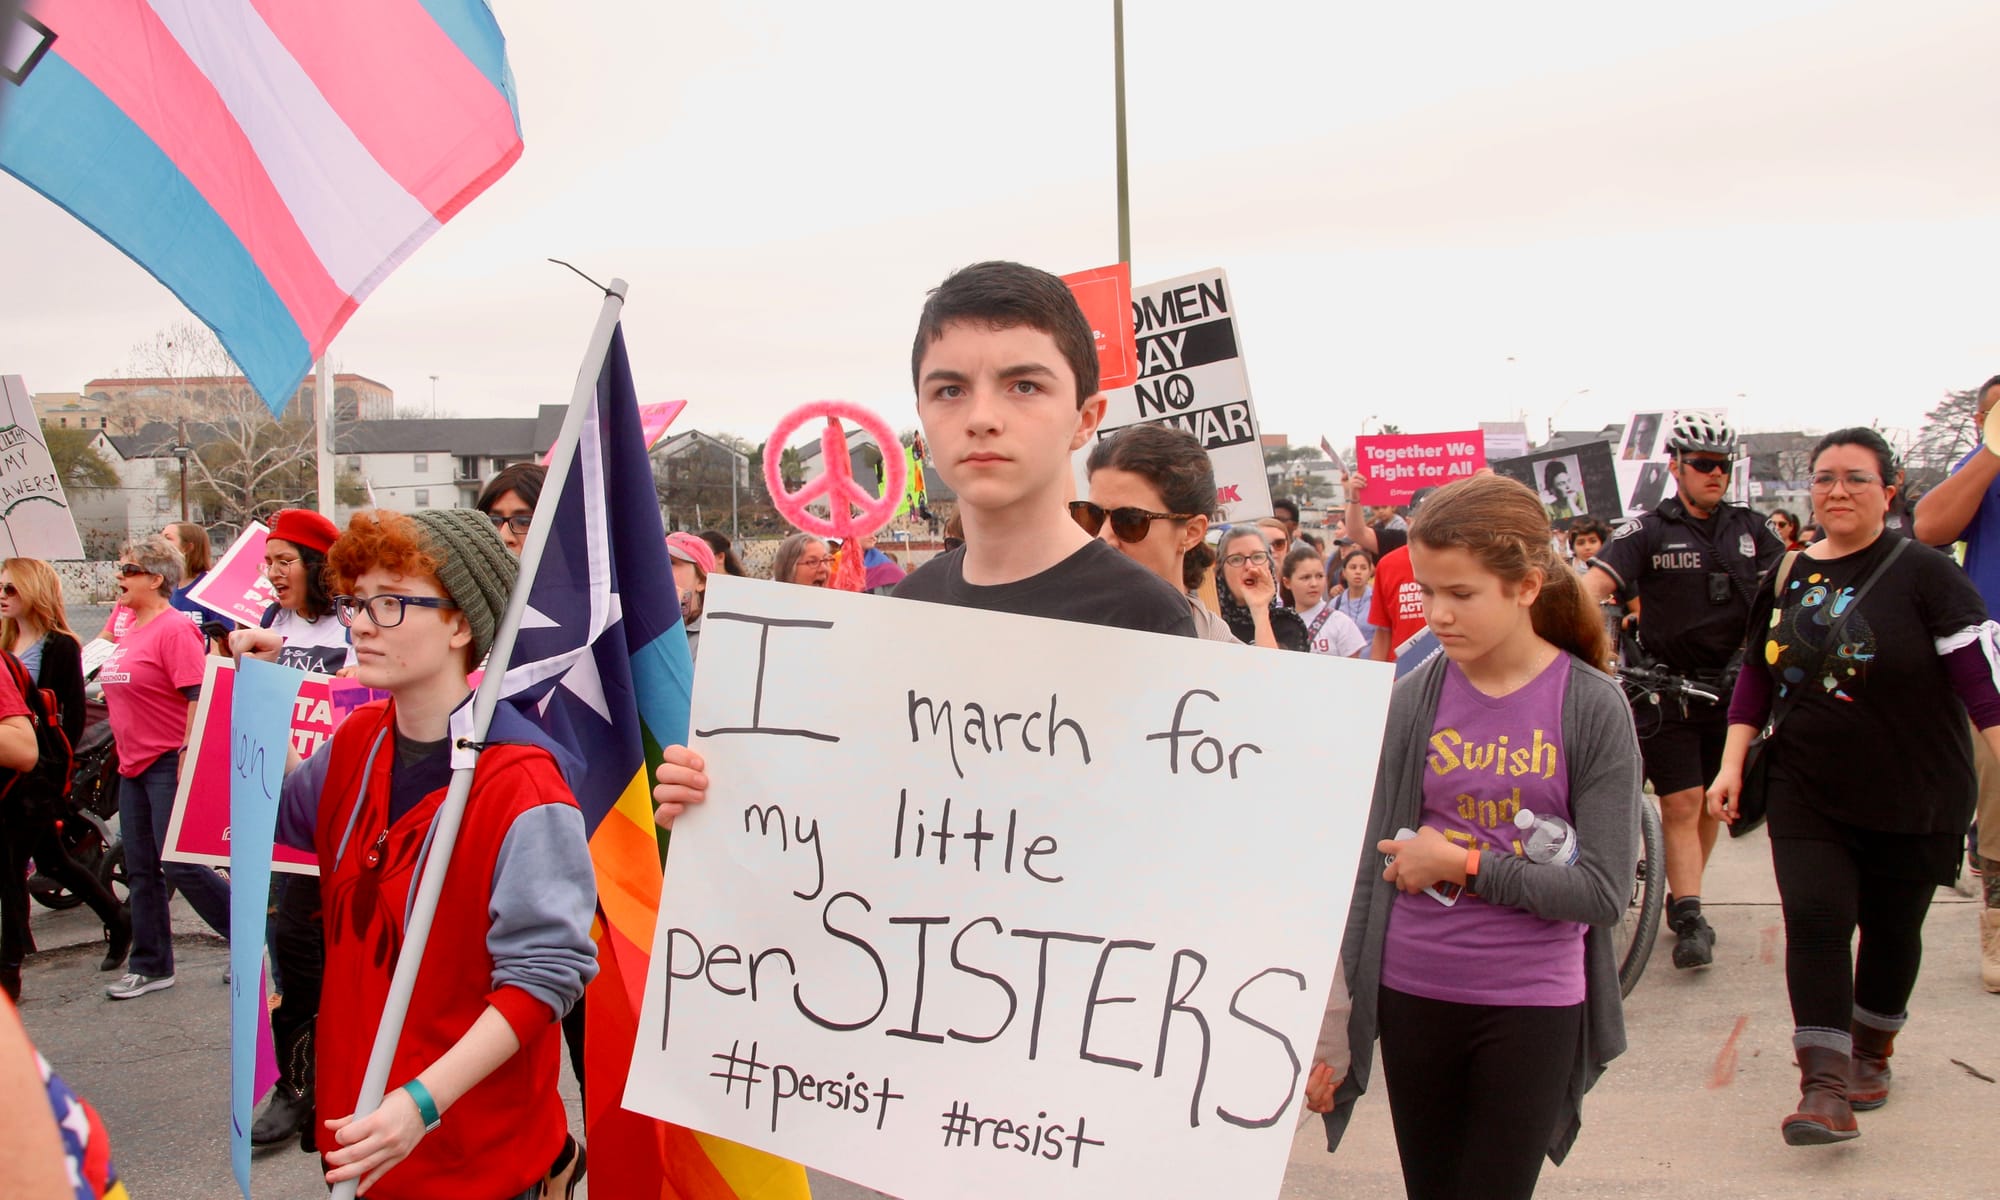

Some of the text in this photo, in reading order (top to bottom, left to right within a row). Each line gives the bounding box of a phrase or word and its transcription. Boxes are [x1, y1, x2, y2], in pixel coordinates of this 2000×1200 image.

[1132, 279, 1227, 335] MEN
[1134, 373, 1194, 419] NO
[5, 448, 28, 472] MY
[1365, 444, 1443, 462] Together
[1446, 442, 1475, 457] We
[1370, 461, 1473, 481] Fight for All
[1, 474, 58, 505] AWERS!
[1652, 553, 1702, 570] POLICE
[1399, 592, 1424, 603] DEM
[1399, 602, 1424, 614] ACT
[294, 696, 333, 725] TA
[695, 611, 1262, 779] I march for
[1428, 728, 1557, 779] Swish
[1455, 787, 1521, 828] and
[745, 789, 1064, 901] my little
[662, 891, 1307, 1129] perSISTERS
[710, 1040, 1105, 1168] #persist #resist
